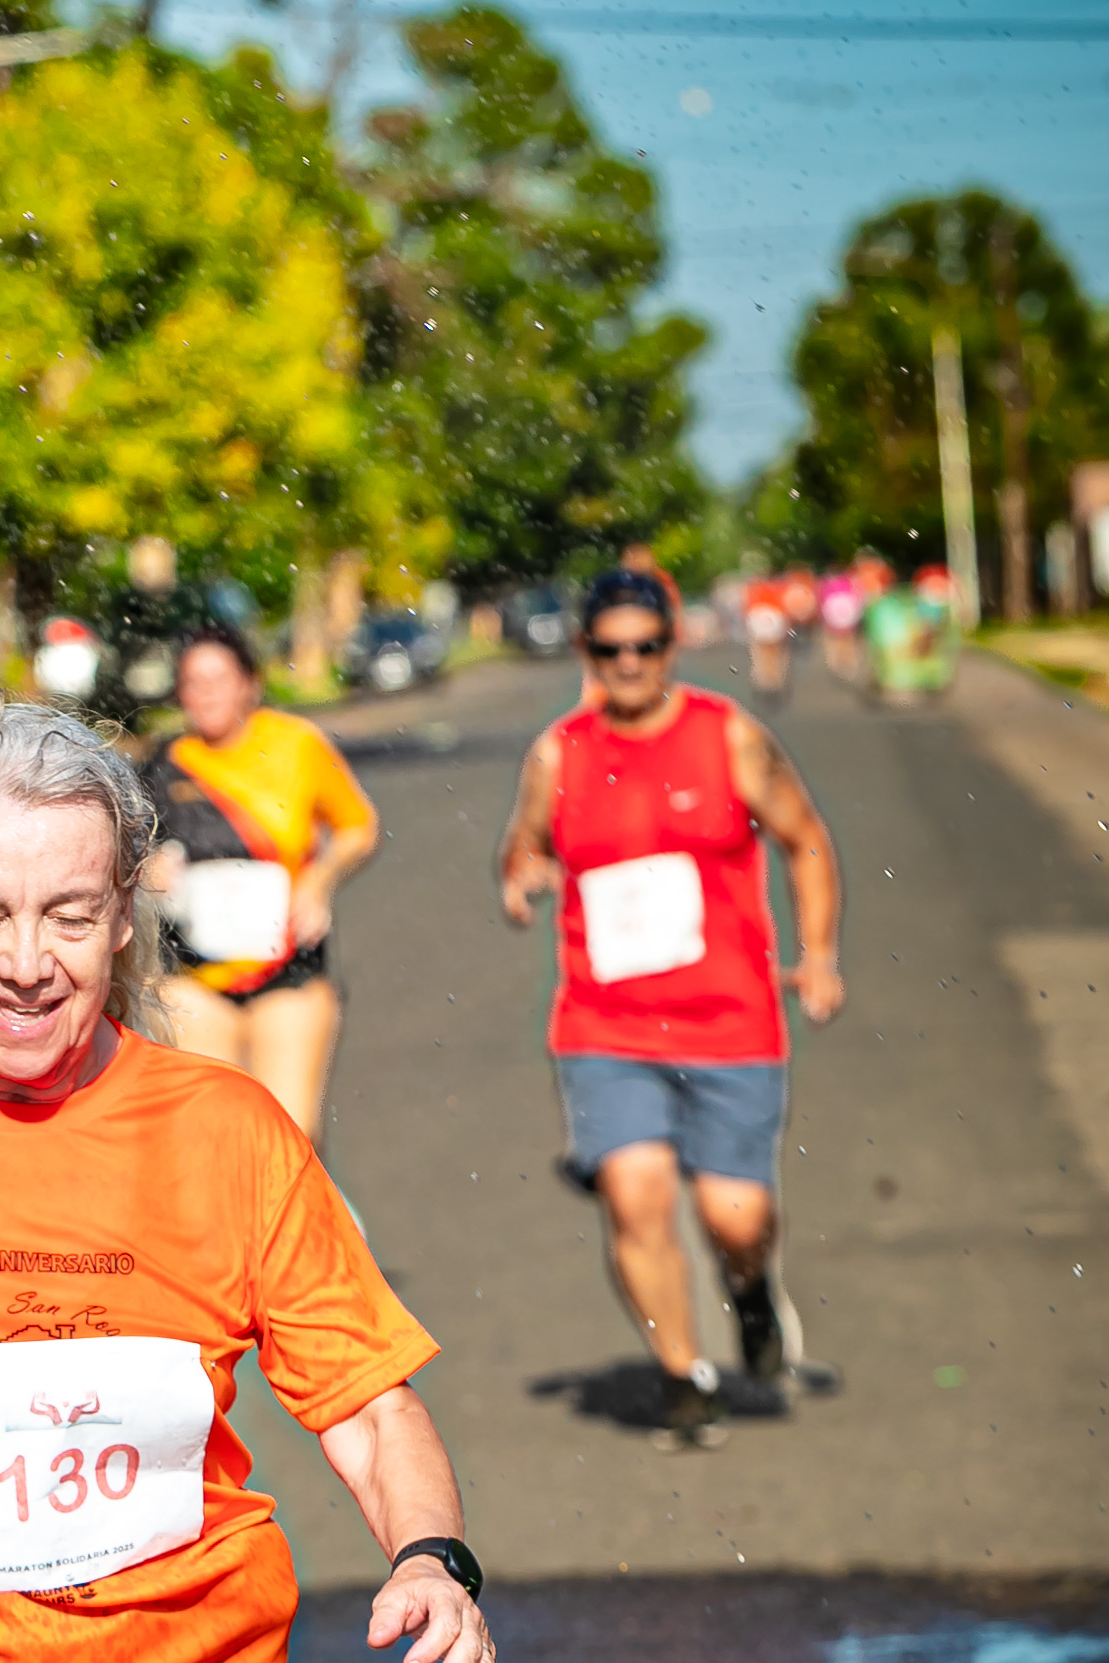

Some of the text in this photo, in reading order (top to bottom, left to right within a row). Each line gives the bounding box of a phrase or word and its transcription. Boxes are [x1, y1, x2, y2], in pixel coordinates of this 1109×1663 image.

[6, 1290, 62, 1320] San
[56, 1549, 110, 1567] SOLIDARIA
[112, 1542, 135, 1555] 2025
